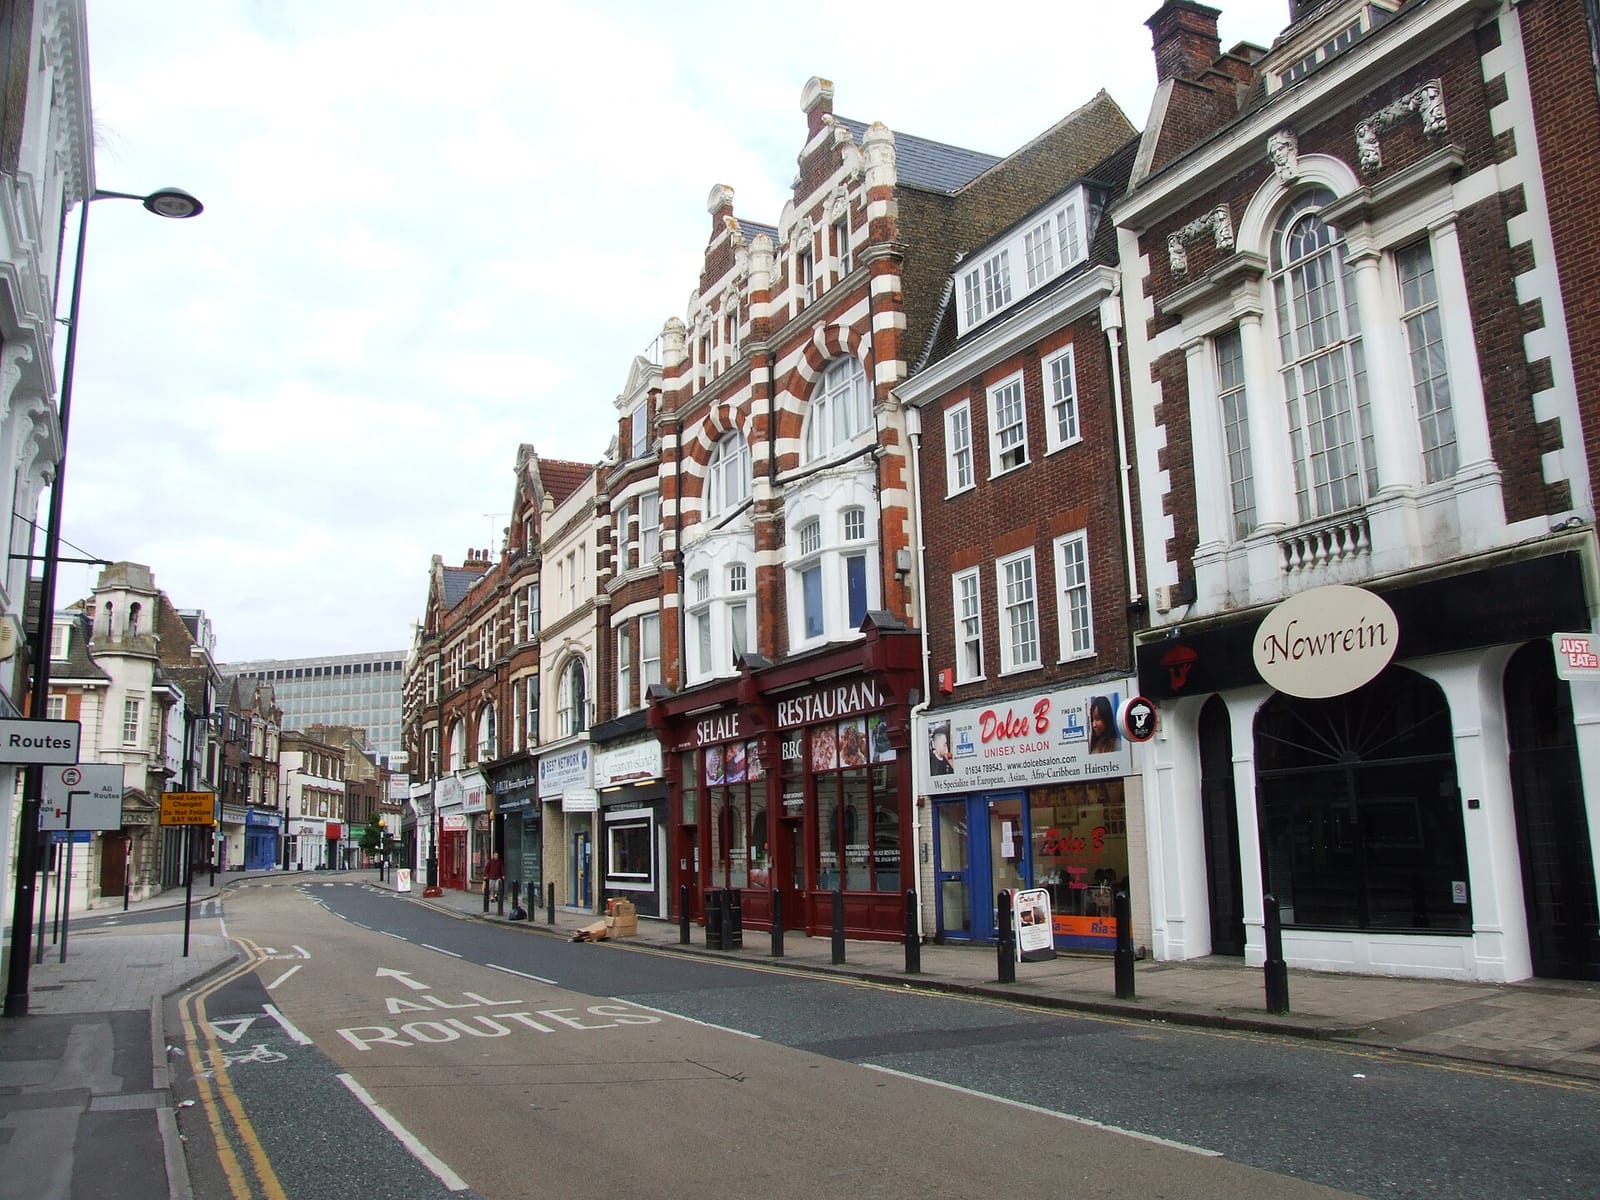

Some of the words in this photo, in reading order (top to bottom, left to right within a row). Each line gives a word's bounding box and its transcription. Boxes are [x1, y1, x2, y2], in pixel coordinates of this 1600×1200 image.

[1263, 617, 1388, 665] Nowrein
[1560, 639, 1588, 653] JUST
[1568, 653, 1590, 667] EAT
[777, 679, 885, 728] RESTAURAN
[979, 709, 1030, 744] Dolce
[1033, 698, 1051, 734] B
[9, 734, 71, 749] Routes
[984, 745, 1016, 758] UNISEX
[1019, 741, 1050, 753] SALON
[1007, 755, 1077, 770] www.dolcebsalon.com
[934, 780, 944, 789] We
[944, 777, 969, 791] Specialize
[970, 777, 976, 785] in
[977, 774, 1006, 788] European,
[1031, 767, 1080, 780] Afro-Caribbean
[1084, 761, 1120, 776] Hairstyles
[1046, 828, 1085, 853] Dolce
[1091, 826, 1106, 853] B
[1091, 919, 1108, 934] Ria
[385, 991, 524, 1014] ALL
[336, 1004, 662, 1051] ROUTES
